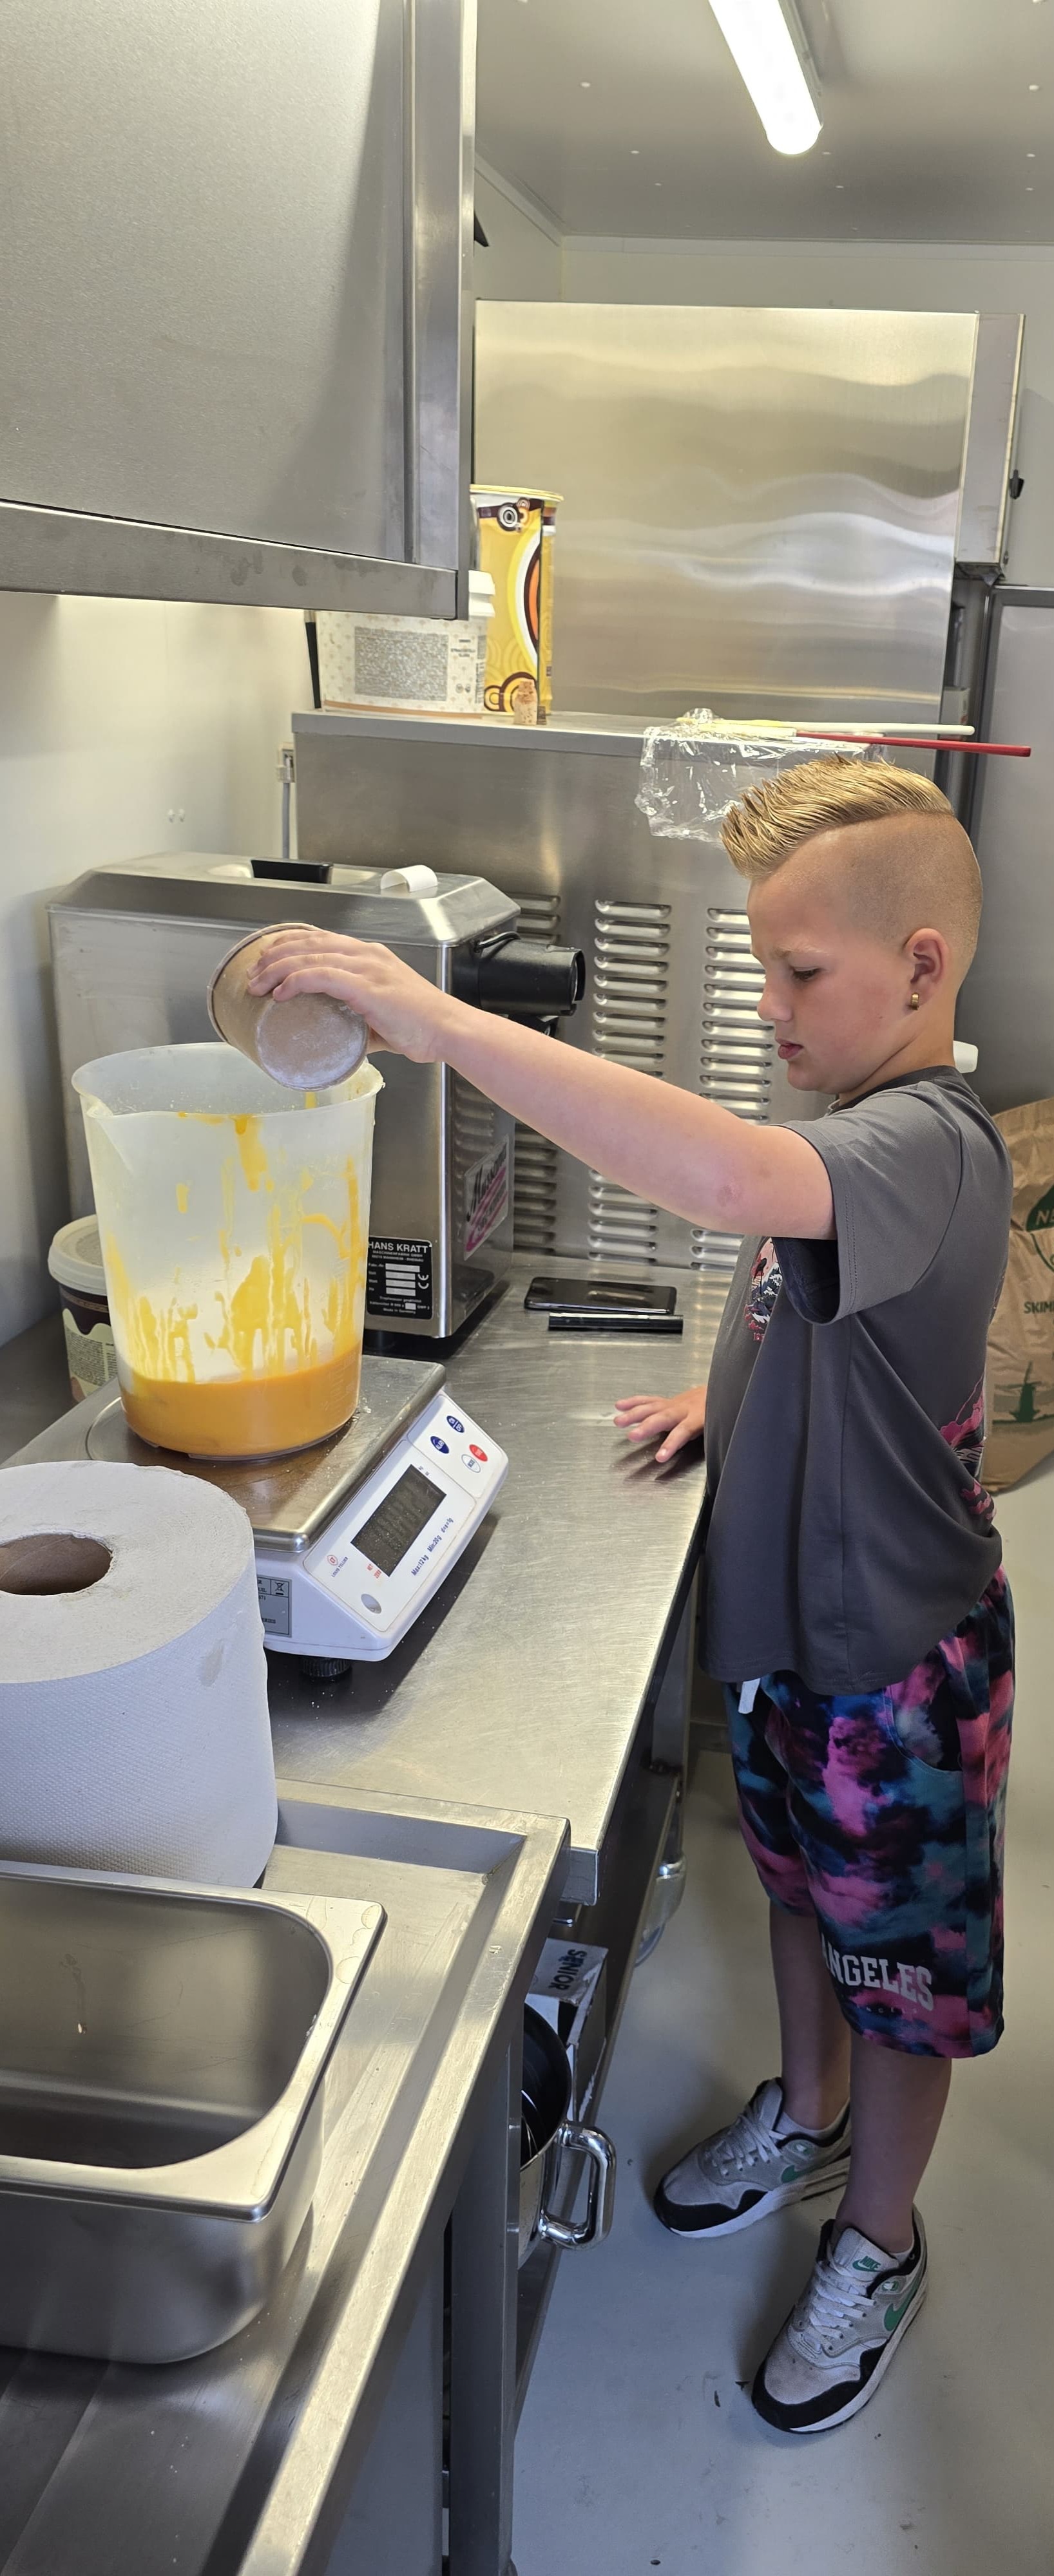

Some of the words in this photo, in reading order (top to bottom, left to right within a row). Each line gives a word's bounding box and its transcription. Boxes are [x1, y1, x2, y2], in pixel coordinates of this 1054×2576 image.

[368, 1242, 394, 1251] HANS
[396, 1244, 428, 1253] KRATT
[548, 1949, 588, 1991] SENIOR
[859, 2255, 881, 2270] NIKE
